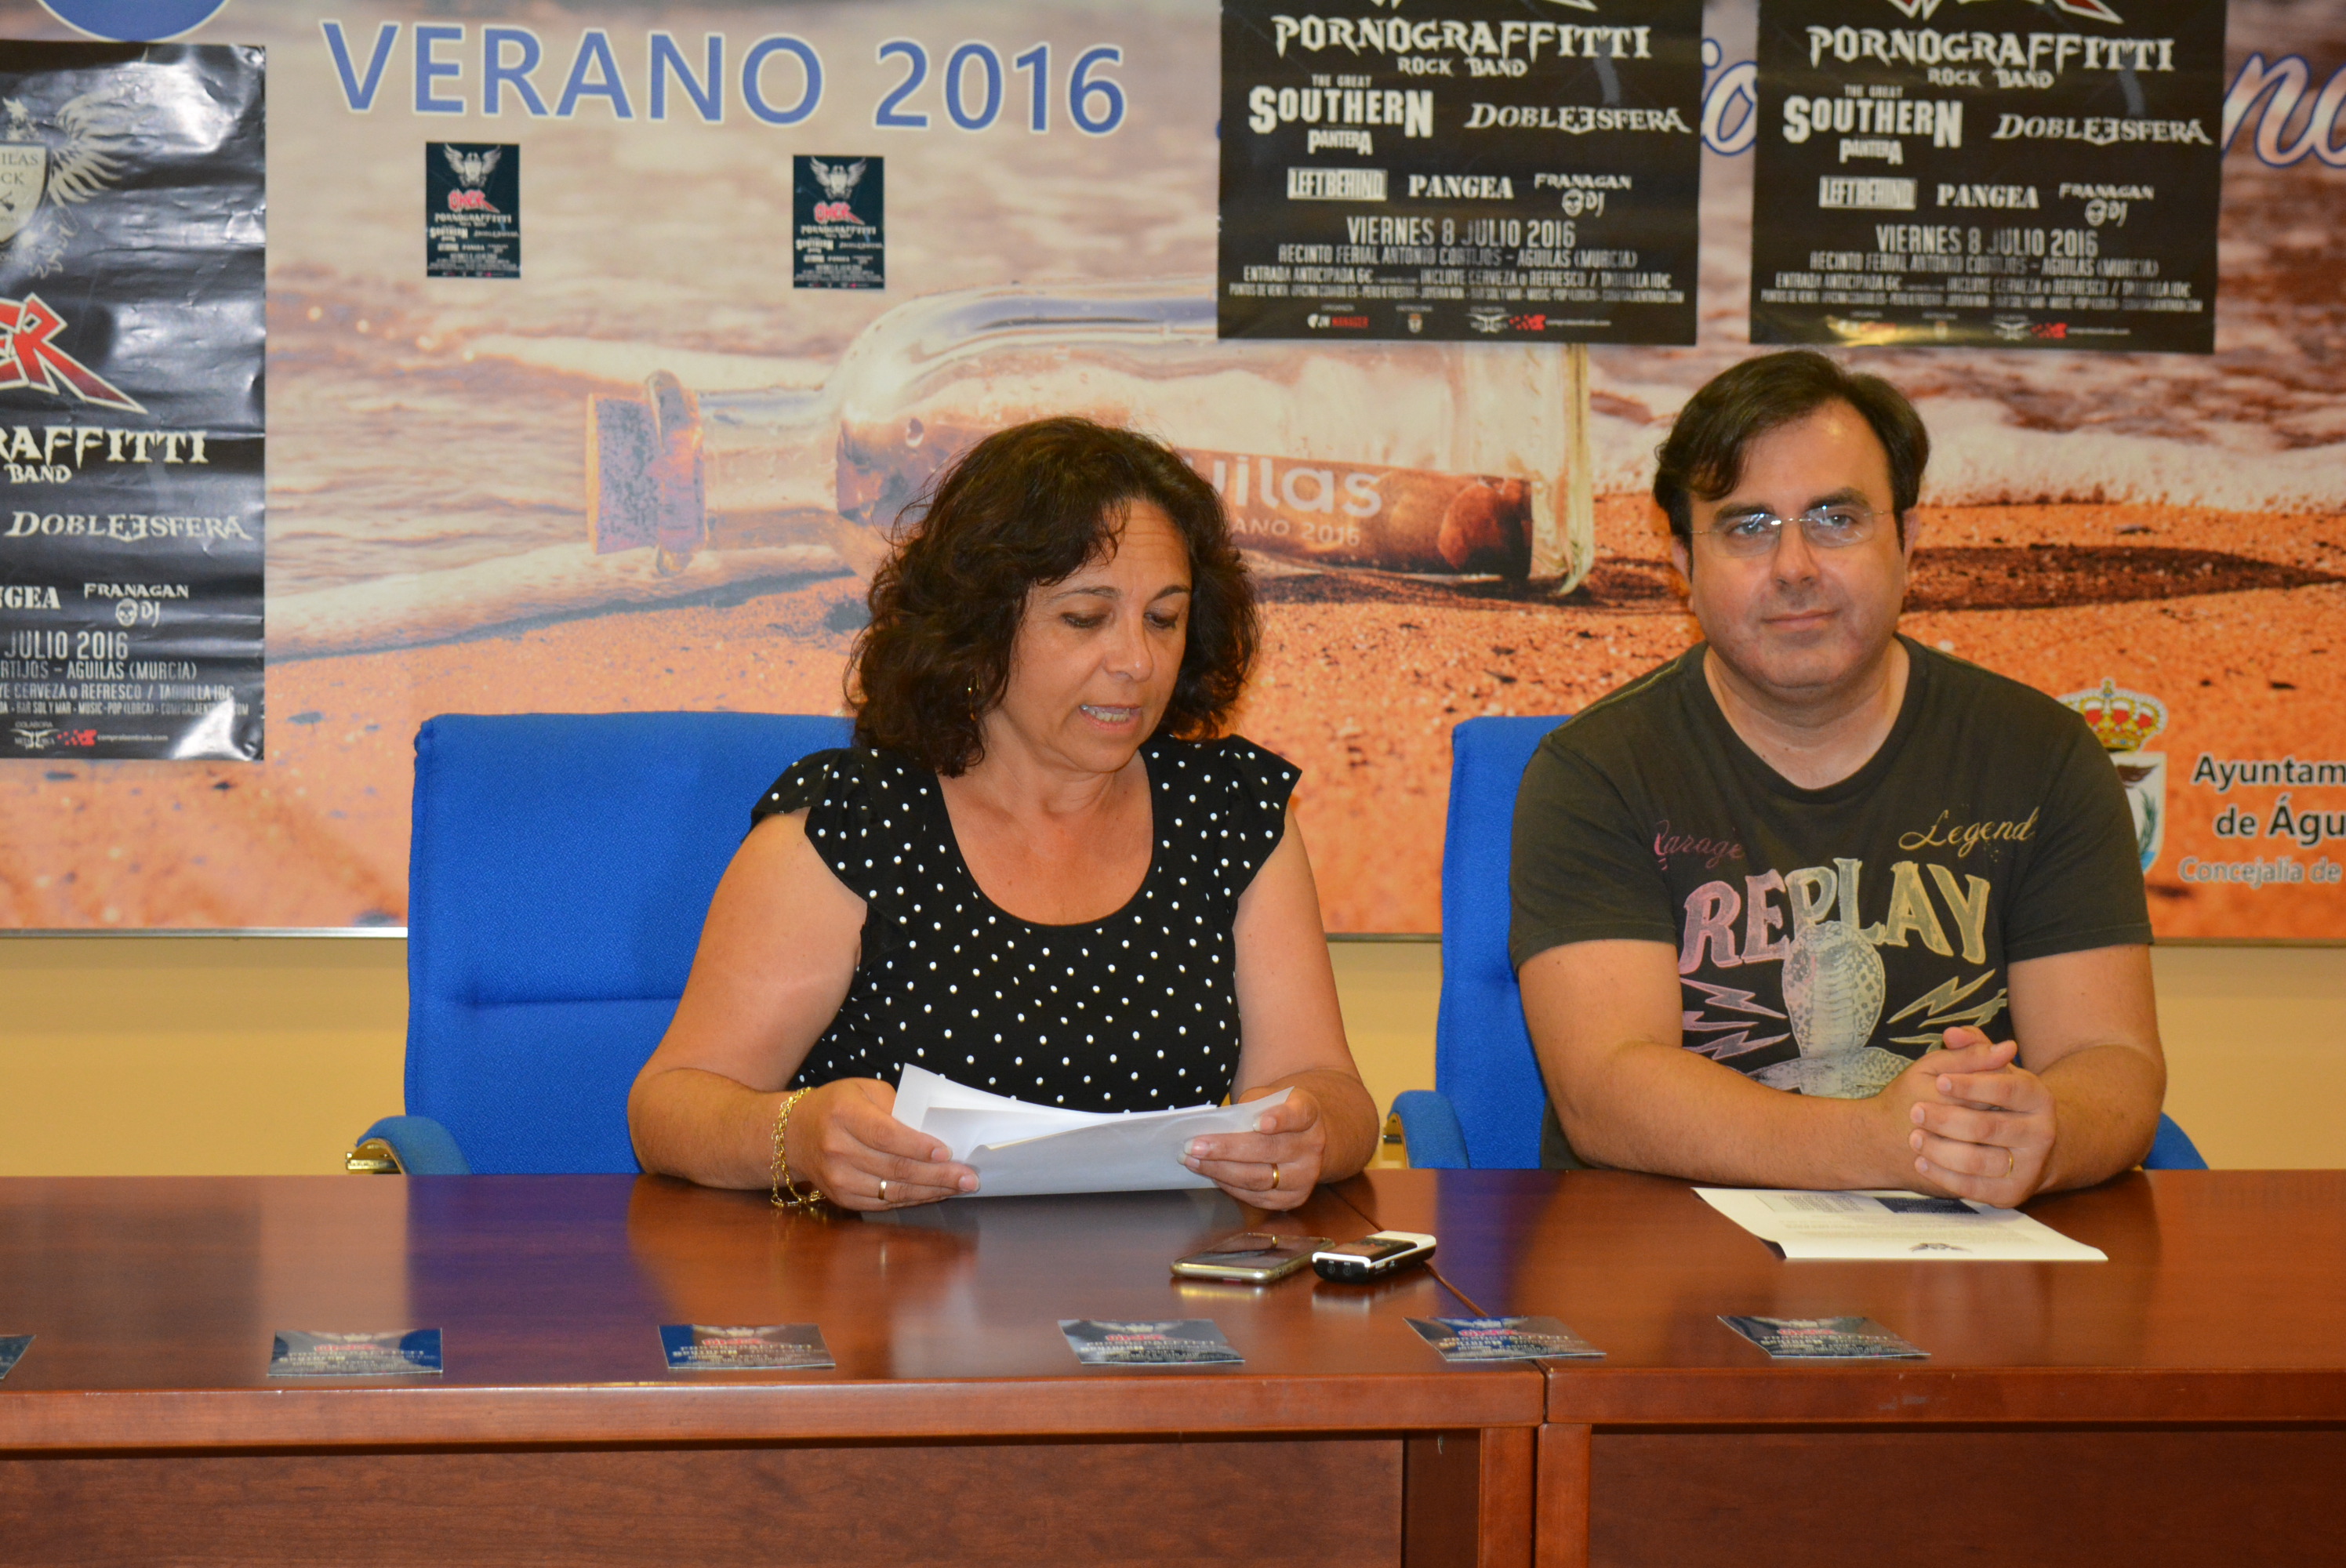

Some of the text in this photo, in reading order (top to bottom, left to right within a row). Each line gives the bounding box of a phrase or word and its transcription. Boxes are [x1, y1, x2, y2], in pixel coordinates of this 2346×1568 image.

[1270, 14, 1652, 63] PORNOGRAFFITTI
[1806, 25, 2175, 74] PORNOGRAFFITTI
[320, 20, 1127, 135] VERANO 2016
[1397, 56, 1529, 78] ROCK BAND
[1927, 67, 2055, 89] ROCK BAND
[1312, 74, 1371, 88] THE GREAT
[1248, 85, 1434, 138] SOUTHERN
[1783, 95, 1963, 148] SOUTHERN
[1307, 129, 1373, 155] PANTERA
[1839, 139, 1904, 165] PANTERA
[1408, 174, 1515, 199] PANGEA
[1534, 172, 1632, 190] FRANAGAN
[1585, 191, 1605, 217] DJ
[1937, 183, 2039, 209] PANGEA
[1346, 216, 1576, 248] VIERNES 8 JULIO 2016
[1876, 224, 2098, 257] VIERNES 8 JULIO 2016
[1278, 244, 1332, 263] RECINTO
[1335, 245, 1379, 265] FERIAL
[1381, 246, 1436, 266] ANTONIO
[1516, 249, 1571, 267] AGUILAS
[1244, 265, 1291, 282] ENTRADA
[1421, 268, 1465, 285] INCLUYE
[3, 463, 72, 484] BAND
[0, 586, 61, 609] GEA
[84, 583, 189, 599] FRANAGAN
[140, 601, 161, 627] DJ
[4, 630, 129, 660] JULIO 2016
[67, 661, 125, 680] AGUILAS
[129, 661, 198, 681] (MURCIA)
[14, 683, 67, 700] CERVEZA
[70, 687, 78, 700] o
[81, 683, 142, 700] REFRESCO
[2194, 755, 2346, 792] Ayuntam
[1898, 807, 2039, 858] Legend
[2216, 795, 2346, 846] de Águ
[2178, 858, 2342, 887] Concejalía de
[1679, 858, 1990, 974] REPLAY
